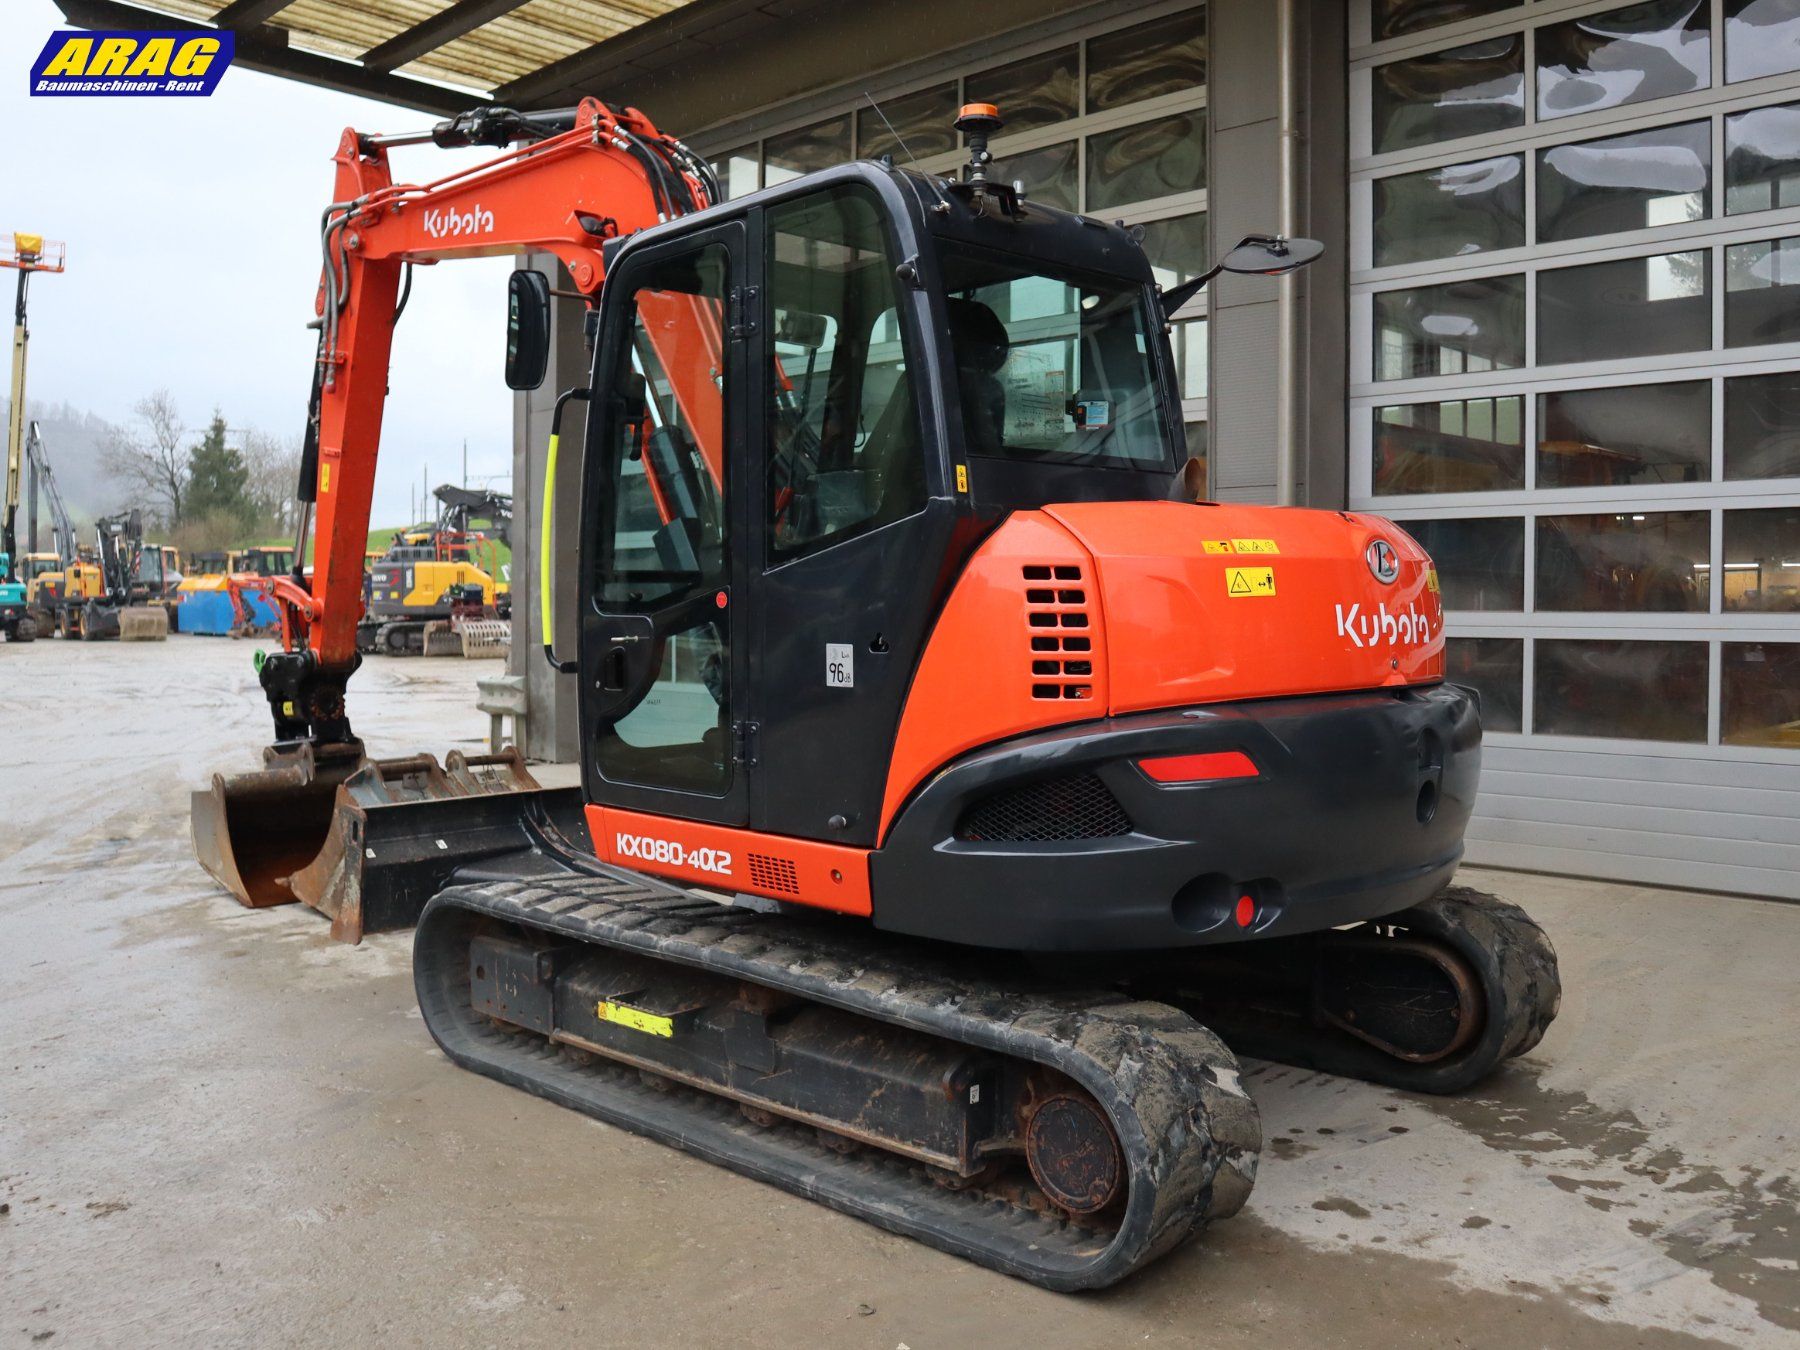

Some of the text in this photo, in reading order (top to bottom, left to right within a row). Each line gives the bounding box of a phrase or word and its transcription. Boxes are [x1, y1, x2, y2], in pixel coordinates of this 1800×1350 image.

[423, 203, 494, 238] Kubota
[1335, 602, 1430, 648] Kubota
[829, 662, 844, 683] 96
